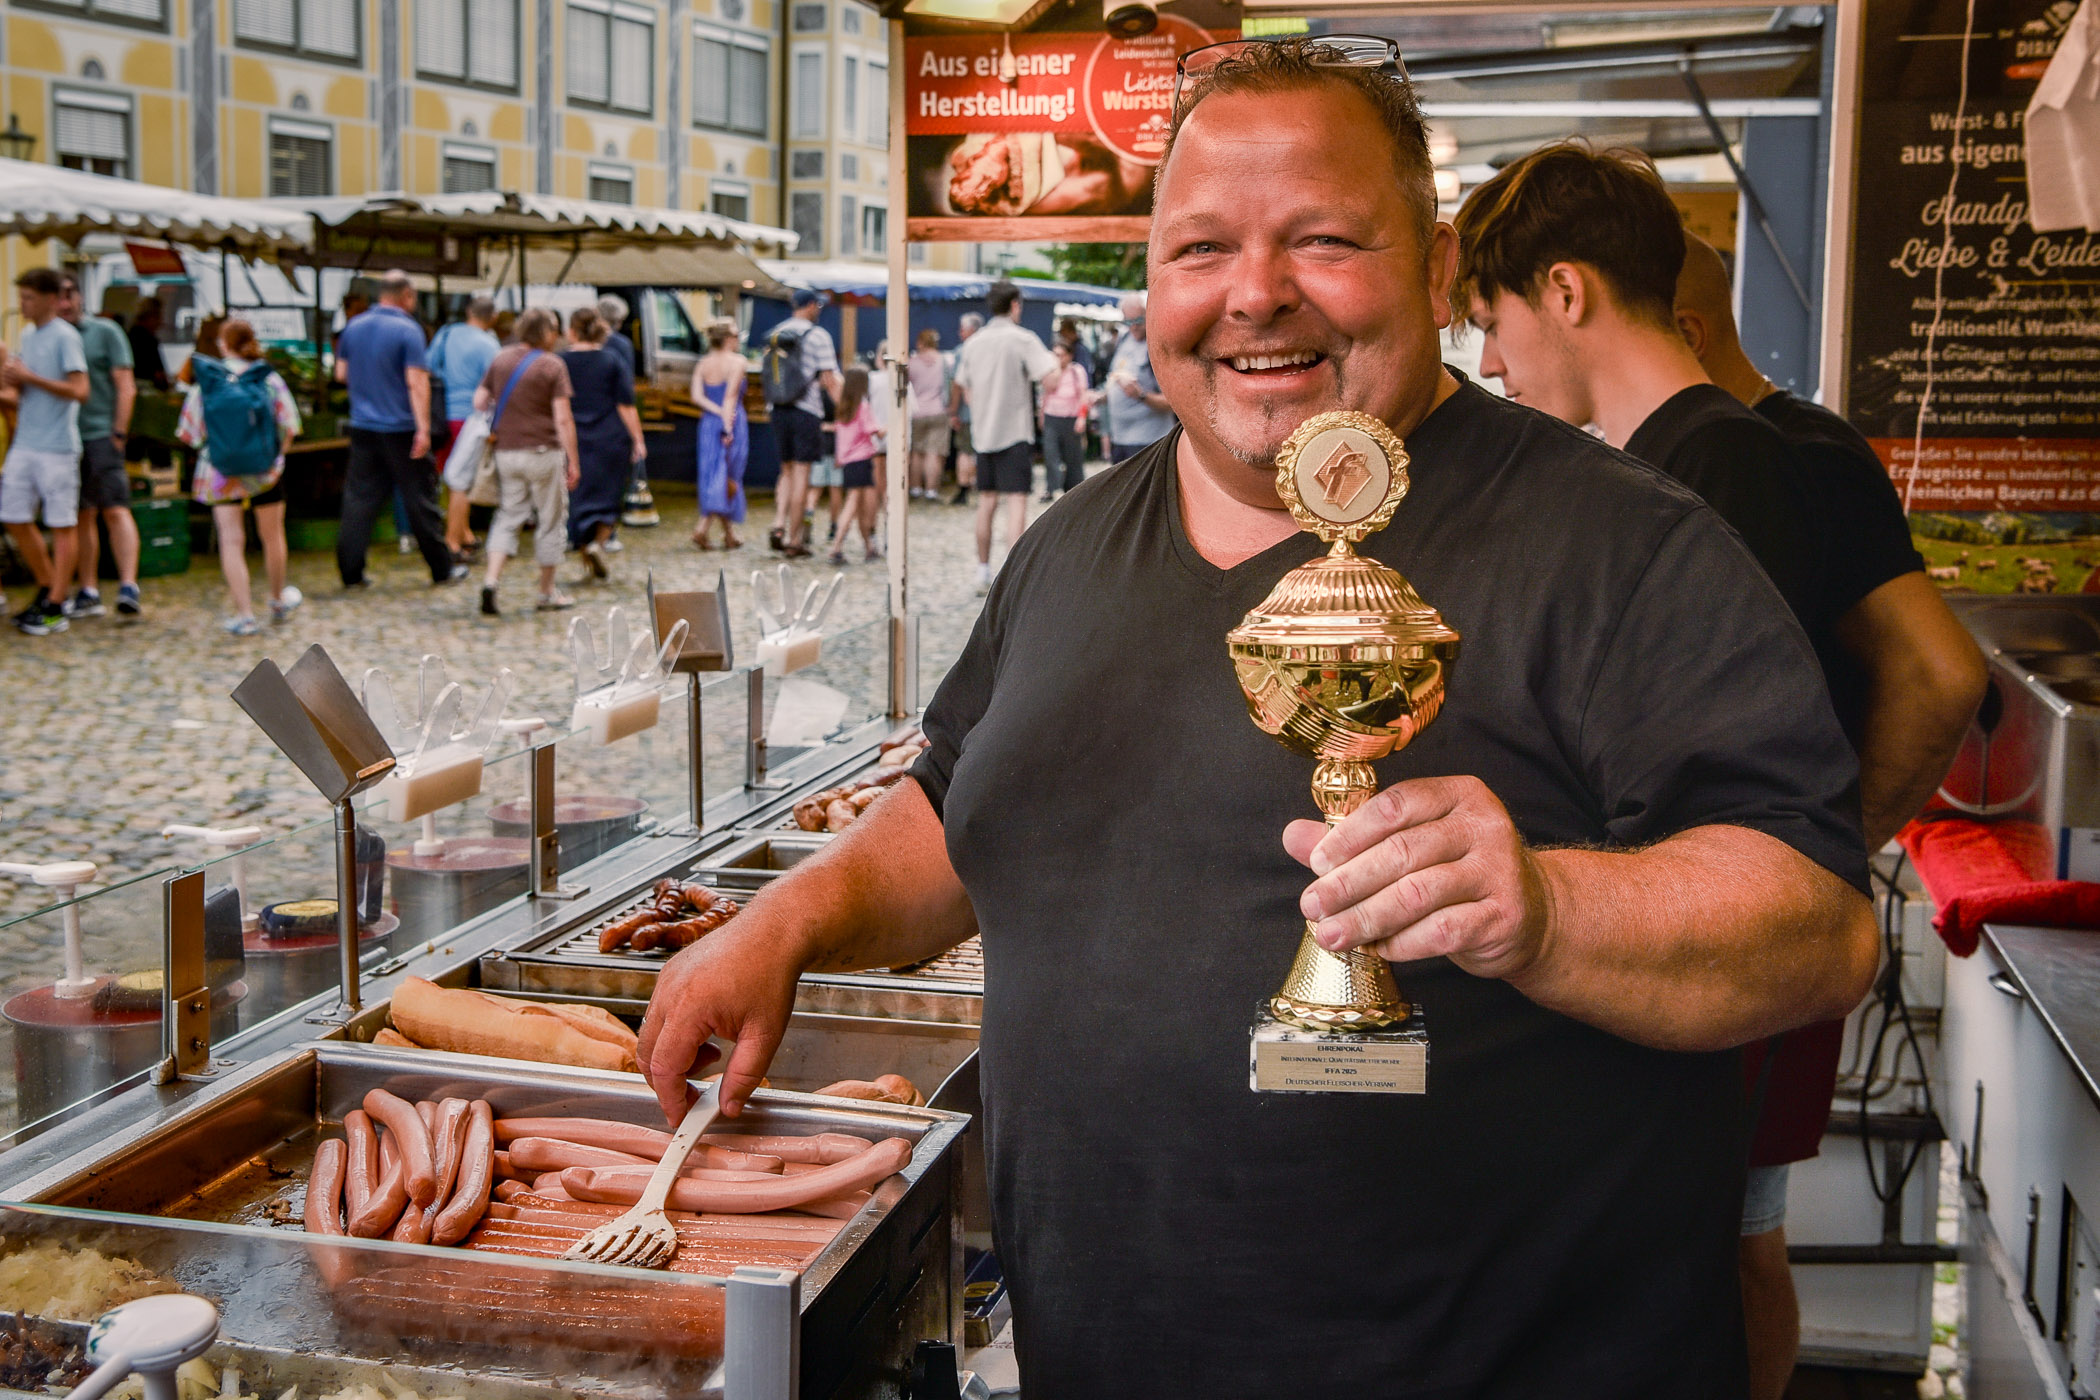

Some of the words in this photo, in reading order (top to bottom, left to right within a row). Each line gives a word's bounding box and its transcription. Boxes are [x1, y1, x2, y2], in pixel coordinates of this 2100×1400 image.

[1167, 34, 1176, 46] &
[1113, 48, 1175, 60] Leidenschaft
[919, 50, 969, 78] Aus
[919, 87, 1077, 123] Herstellung!
[1930, 113, 1990, 131] Wurst-
[1993, 112, 2008, 130] &
[1901, 145, 1945, 164] aus
[1889, 237, 1979, 278] Liebe
[1986, 236, 2011, 268] &
[1941, 346, 2006, 365] Grundlage
[2037, 368, 2063, 383] und
[1893, 391, 1915, 404] die
[1916, 392, 1937, 404] wr
[1938, 390, 1953, 404] in
[1953, 392, 2001, 404] unserer
[2002, 391, 2053, 406] eigenen
[1939, 410, 1963, 424] viel
[1964, 410, 2027, 428] Erfahrung
[2028, 411, 2058, 424] stets
[1953, 445, 1975, 461] Sie
[1888, 463, 1983, 484] Erzeugnisse
[1997, 484, 2056, 503] Bauern
[1317, 1045, 1365, 1053] EHRENPOKAL
[1325, 1067, 1341, 1075] IFFA
[1341, 1067, 1358, 1076] 2025
